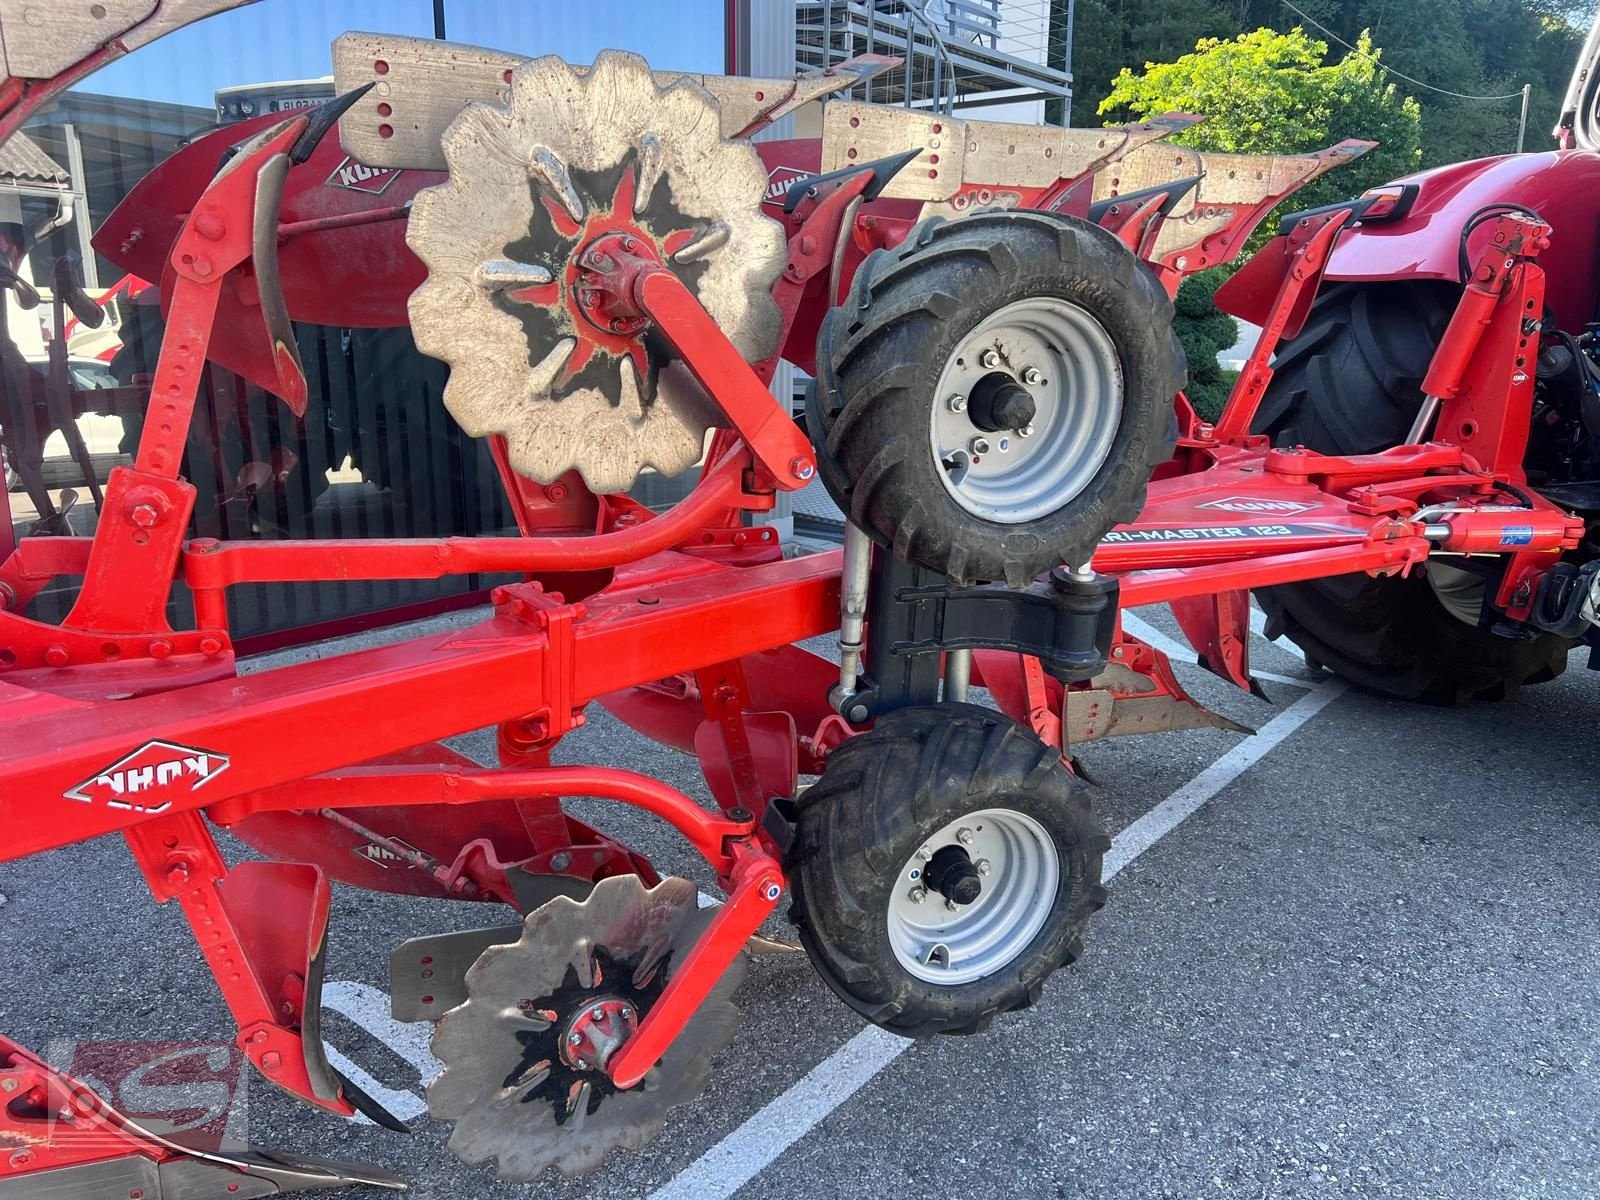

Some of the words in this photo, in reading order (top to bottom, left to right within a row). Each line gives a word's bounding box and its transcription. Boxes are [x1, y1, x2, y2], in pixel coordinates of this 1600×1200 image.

[340, 163, 394, 186] KU
[1101, 527, 1248, 542] RI-MASTER
[1249, 525, 1292, 536] 123
[97, 754, 209, 795] KUHN
